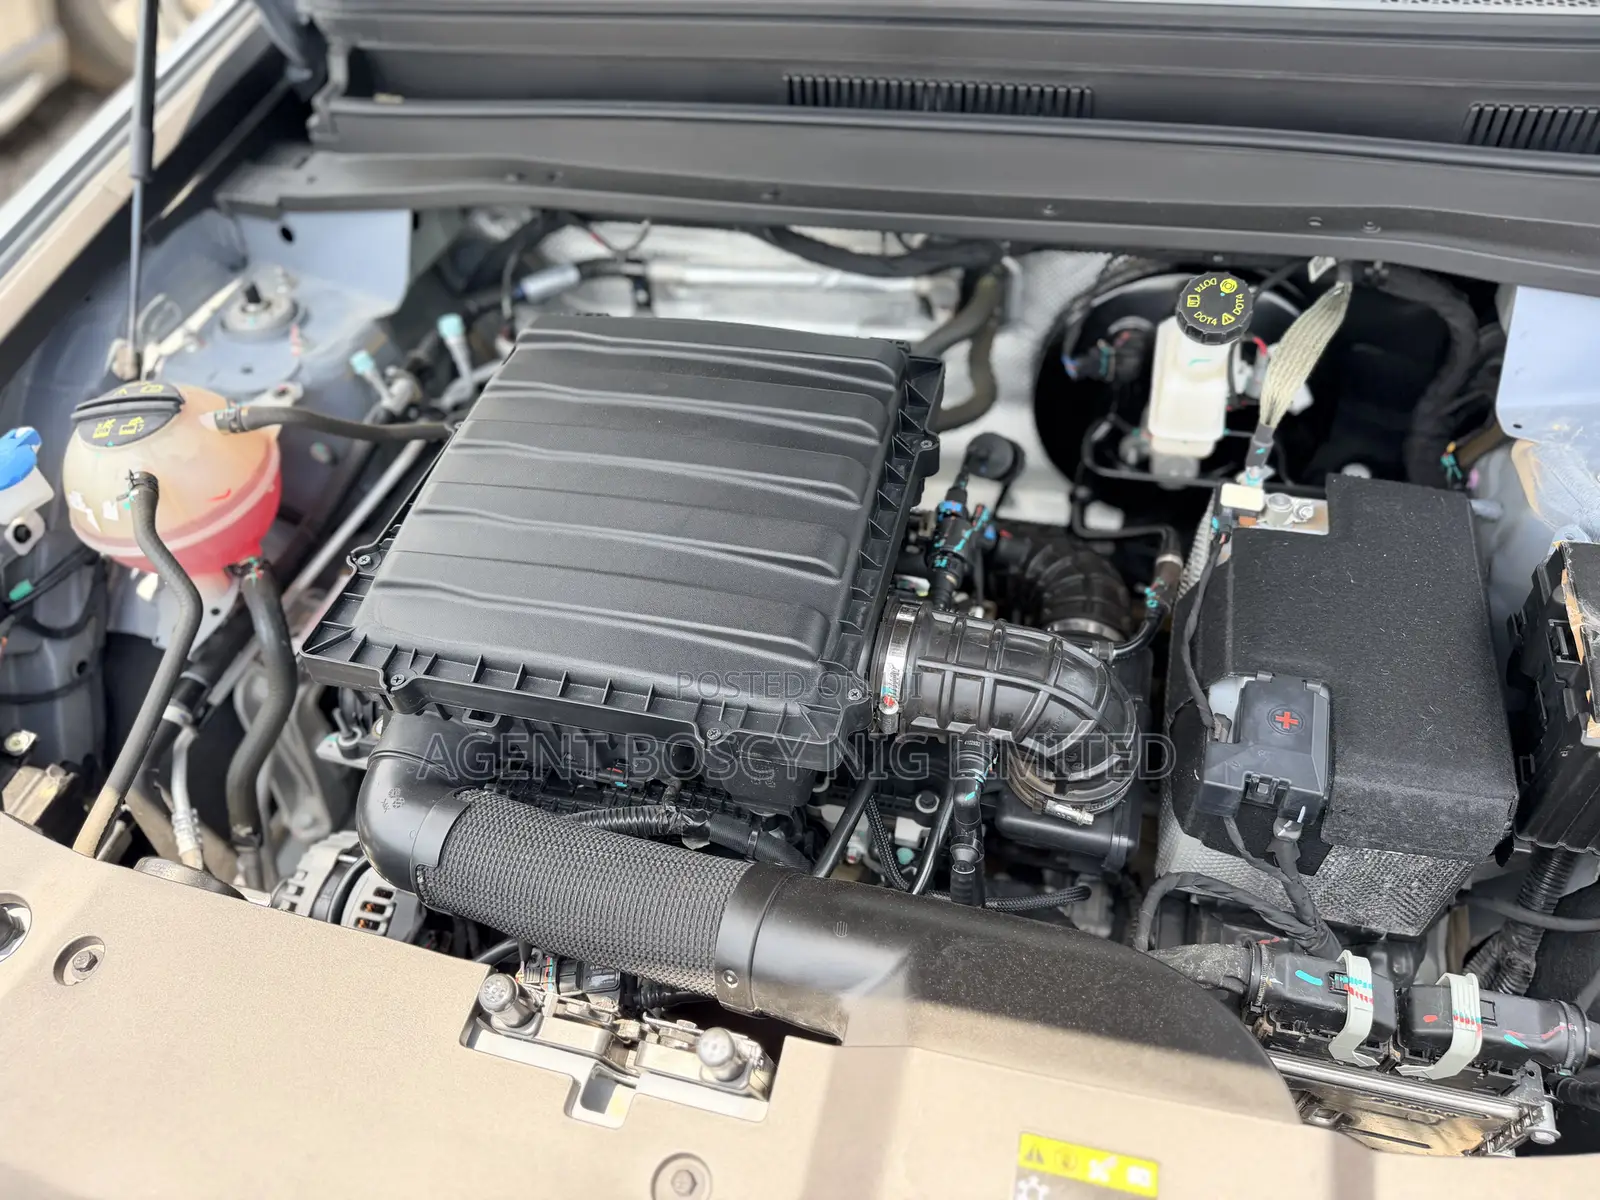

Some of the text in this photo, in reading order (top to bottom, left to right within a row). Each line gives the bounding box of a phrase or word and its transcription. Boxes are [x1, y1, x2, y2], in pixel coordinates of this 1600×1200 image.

[1194, 277, 1217, 293] DOT4
[1232, 293, 1244, 315] DOT4
[1194, 311, 1217, 326] DOT4
